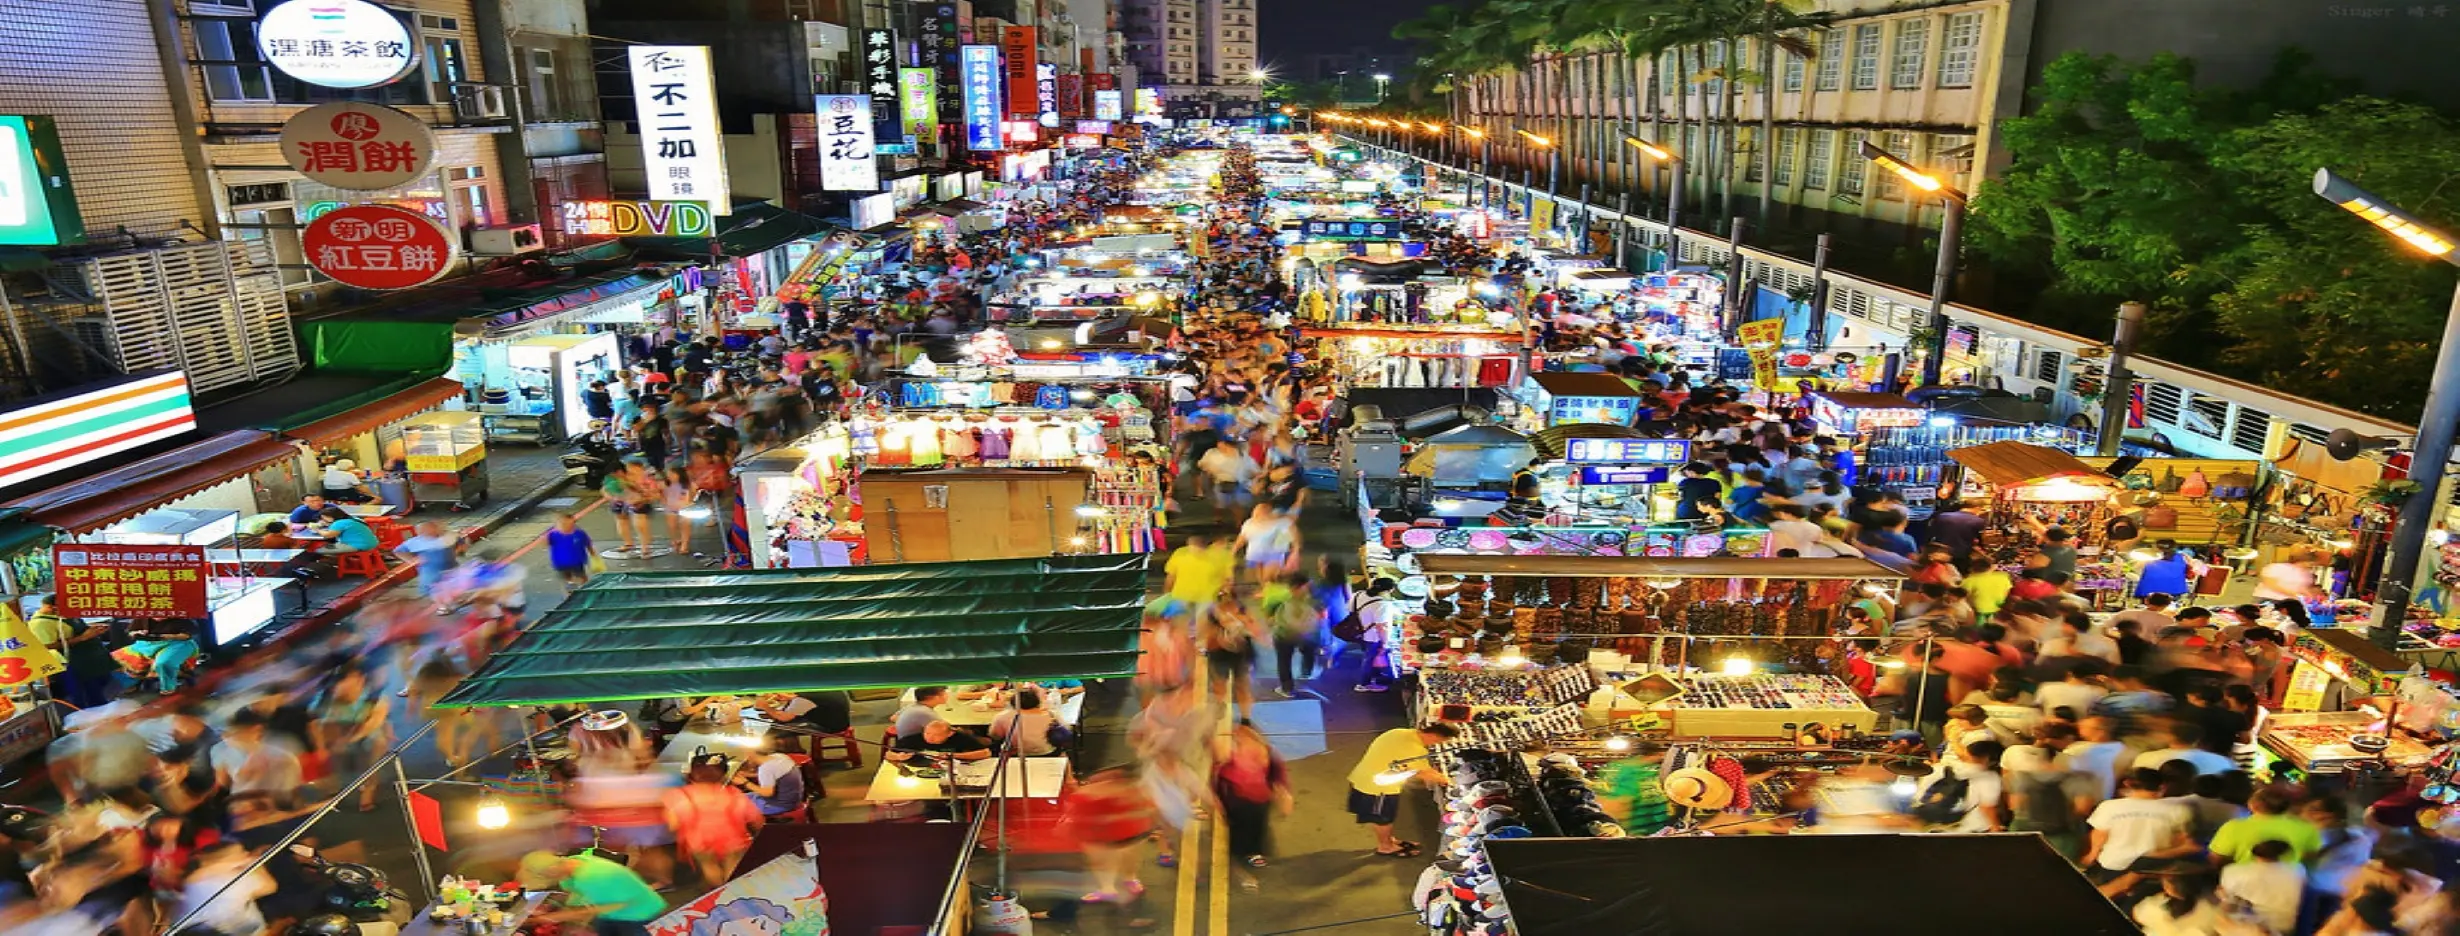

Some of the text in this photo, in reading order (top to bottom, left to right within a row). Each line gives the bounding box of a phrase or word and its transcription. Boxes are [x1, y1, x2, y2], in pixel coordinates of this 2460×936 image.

[650, 82, 696, 195] 不二加 眼鏡
[827, 115, 870, 161] 豆花
[297, 140, 419, 173] 潤餅
[334, 221, 410, 239] 新明
[610, 201, 710, 235] DVD
[317, 244, 437, 271] 紅豆餅
[64, 568, 198, 582] 中東沙威瑪
[67, 596, 174, 609] 印度奶茶
